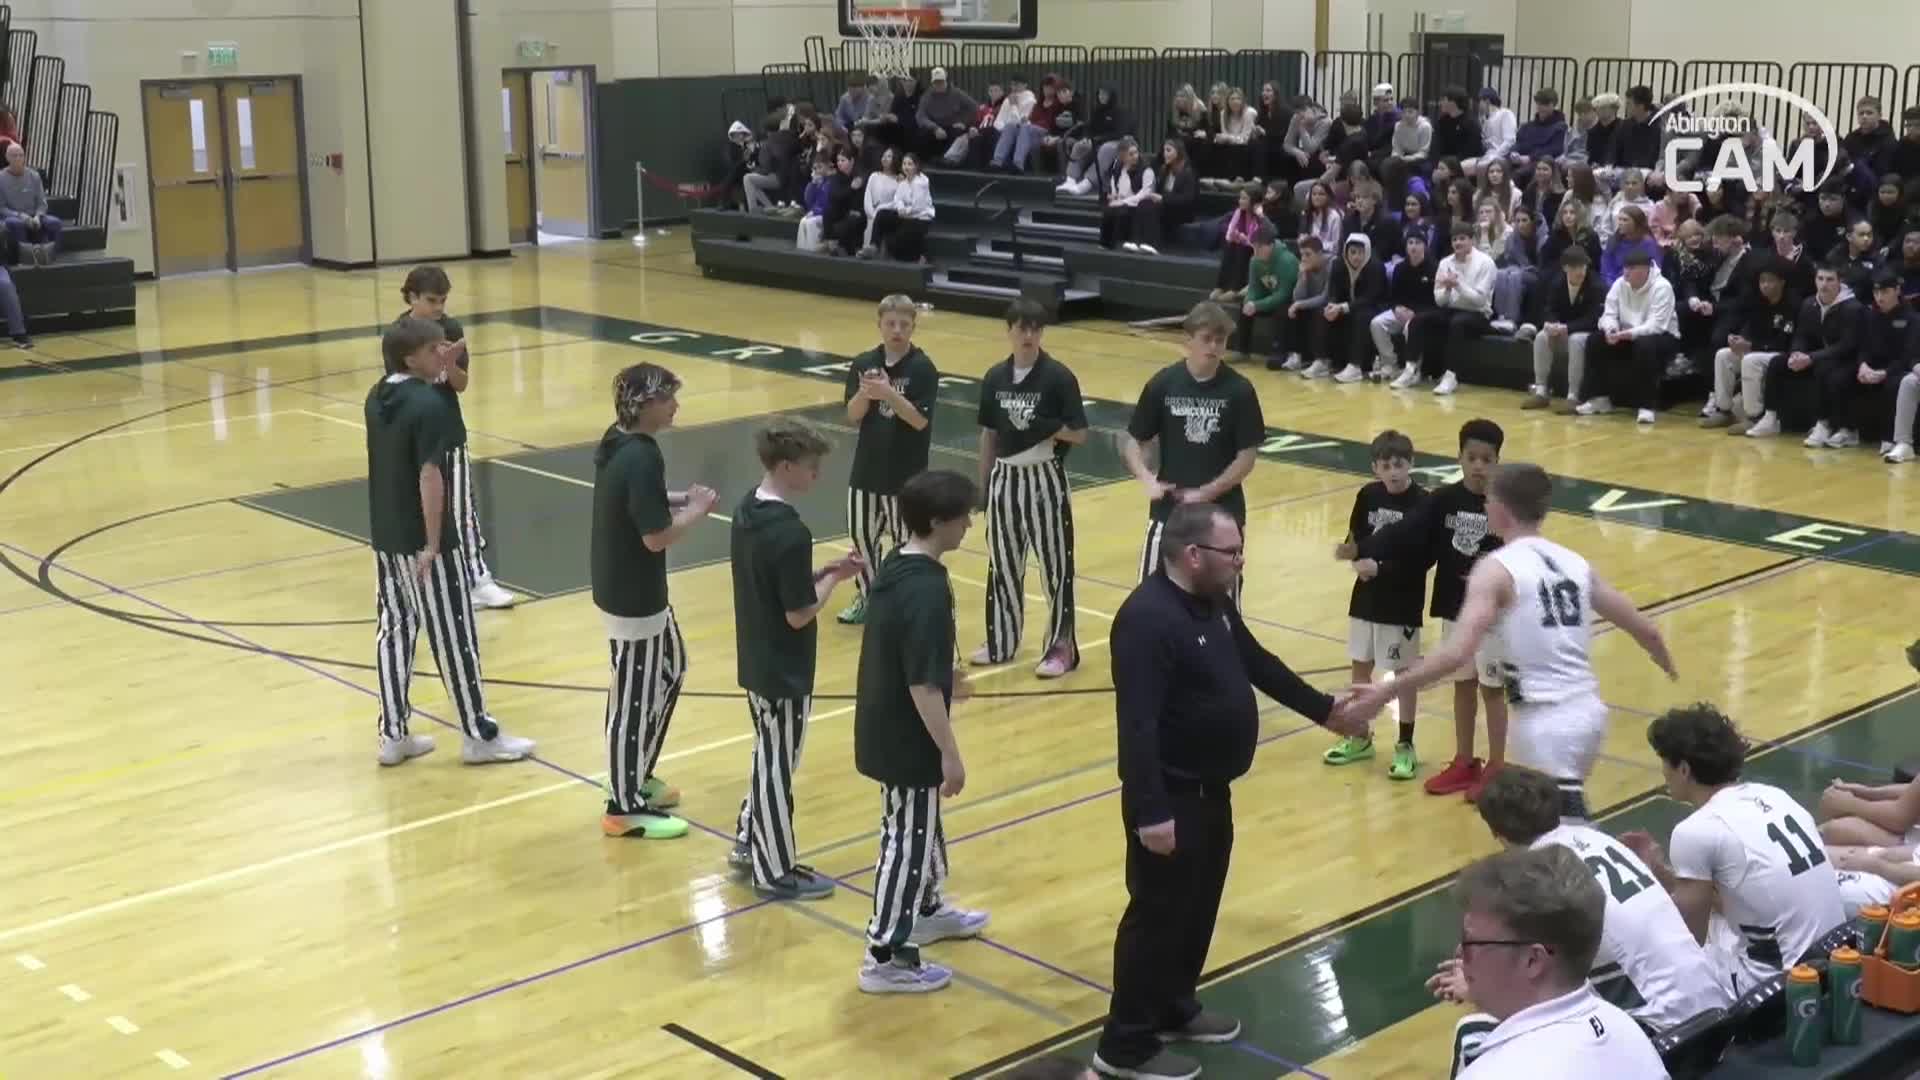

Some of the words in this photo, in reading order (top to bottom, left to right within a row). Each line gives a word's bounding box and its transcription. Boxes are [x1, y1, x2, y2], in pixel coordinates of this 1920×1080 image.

[1538, 578, 1581, 627] 10
[1584, 845, 1655, 904] 21
[1766, 813, 1826, 877] 11
